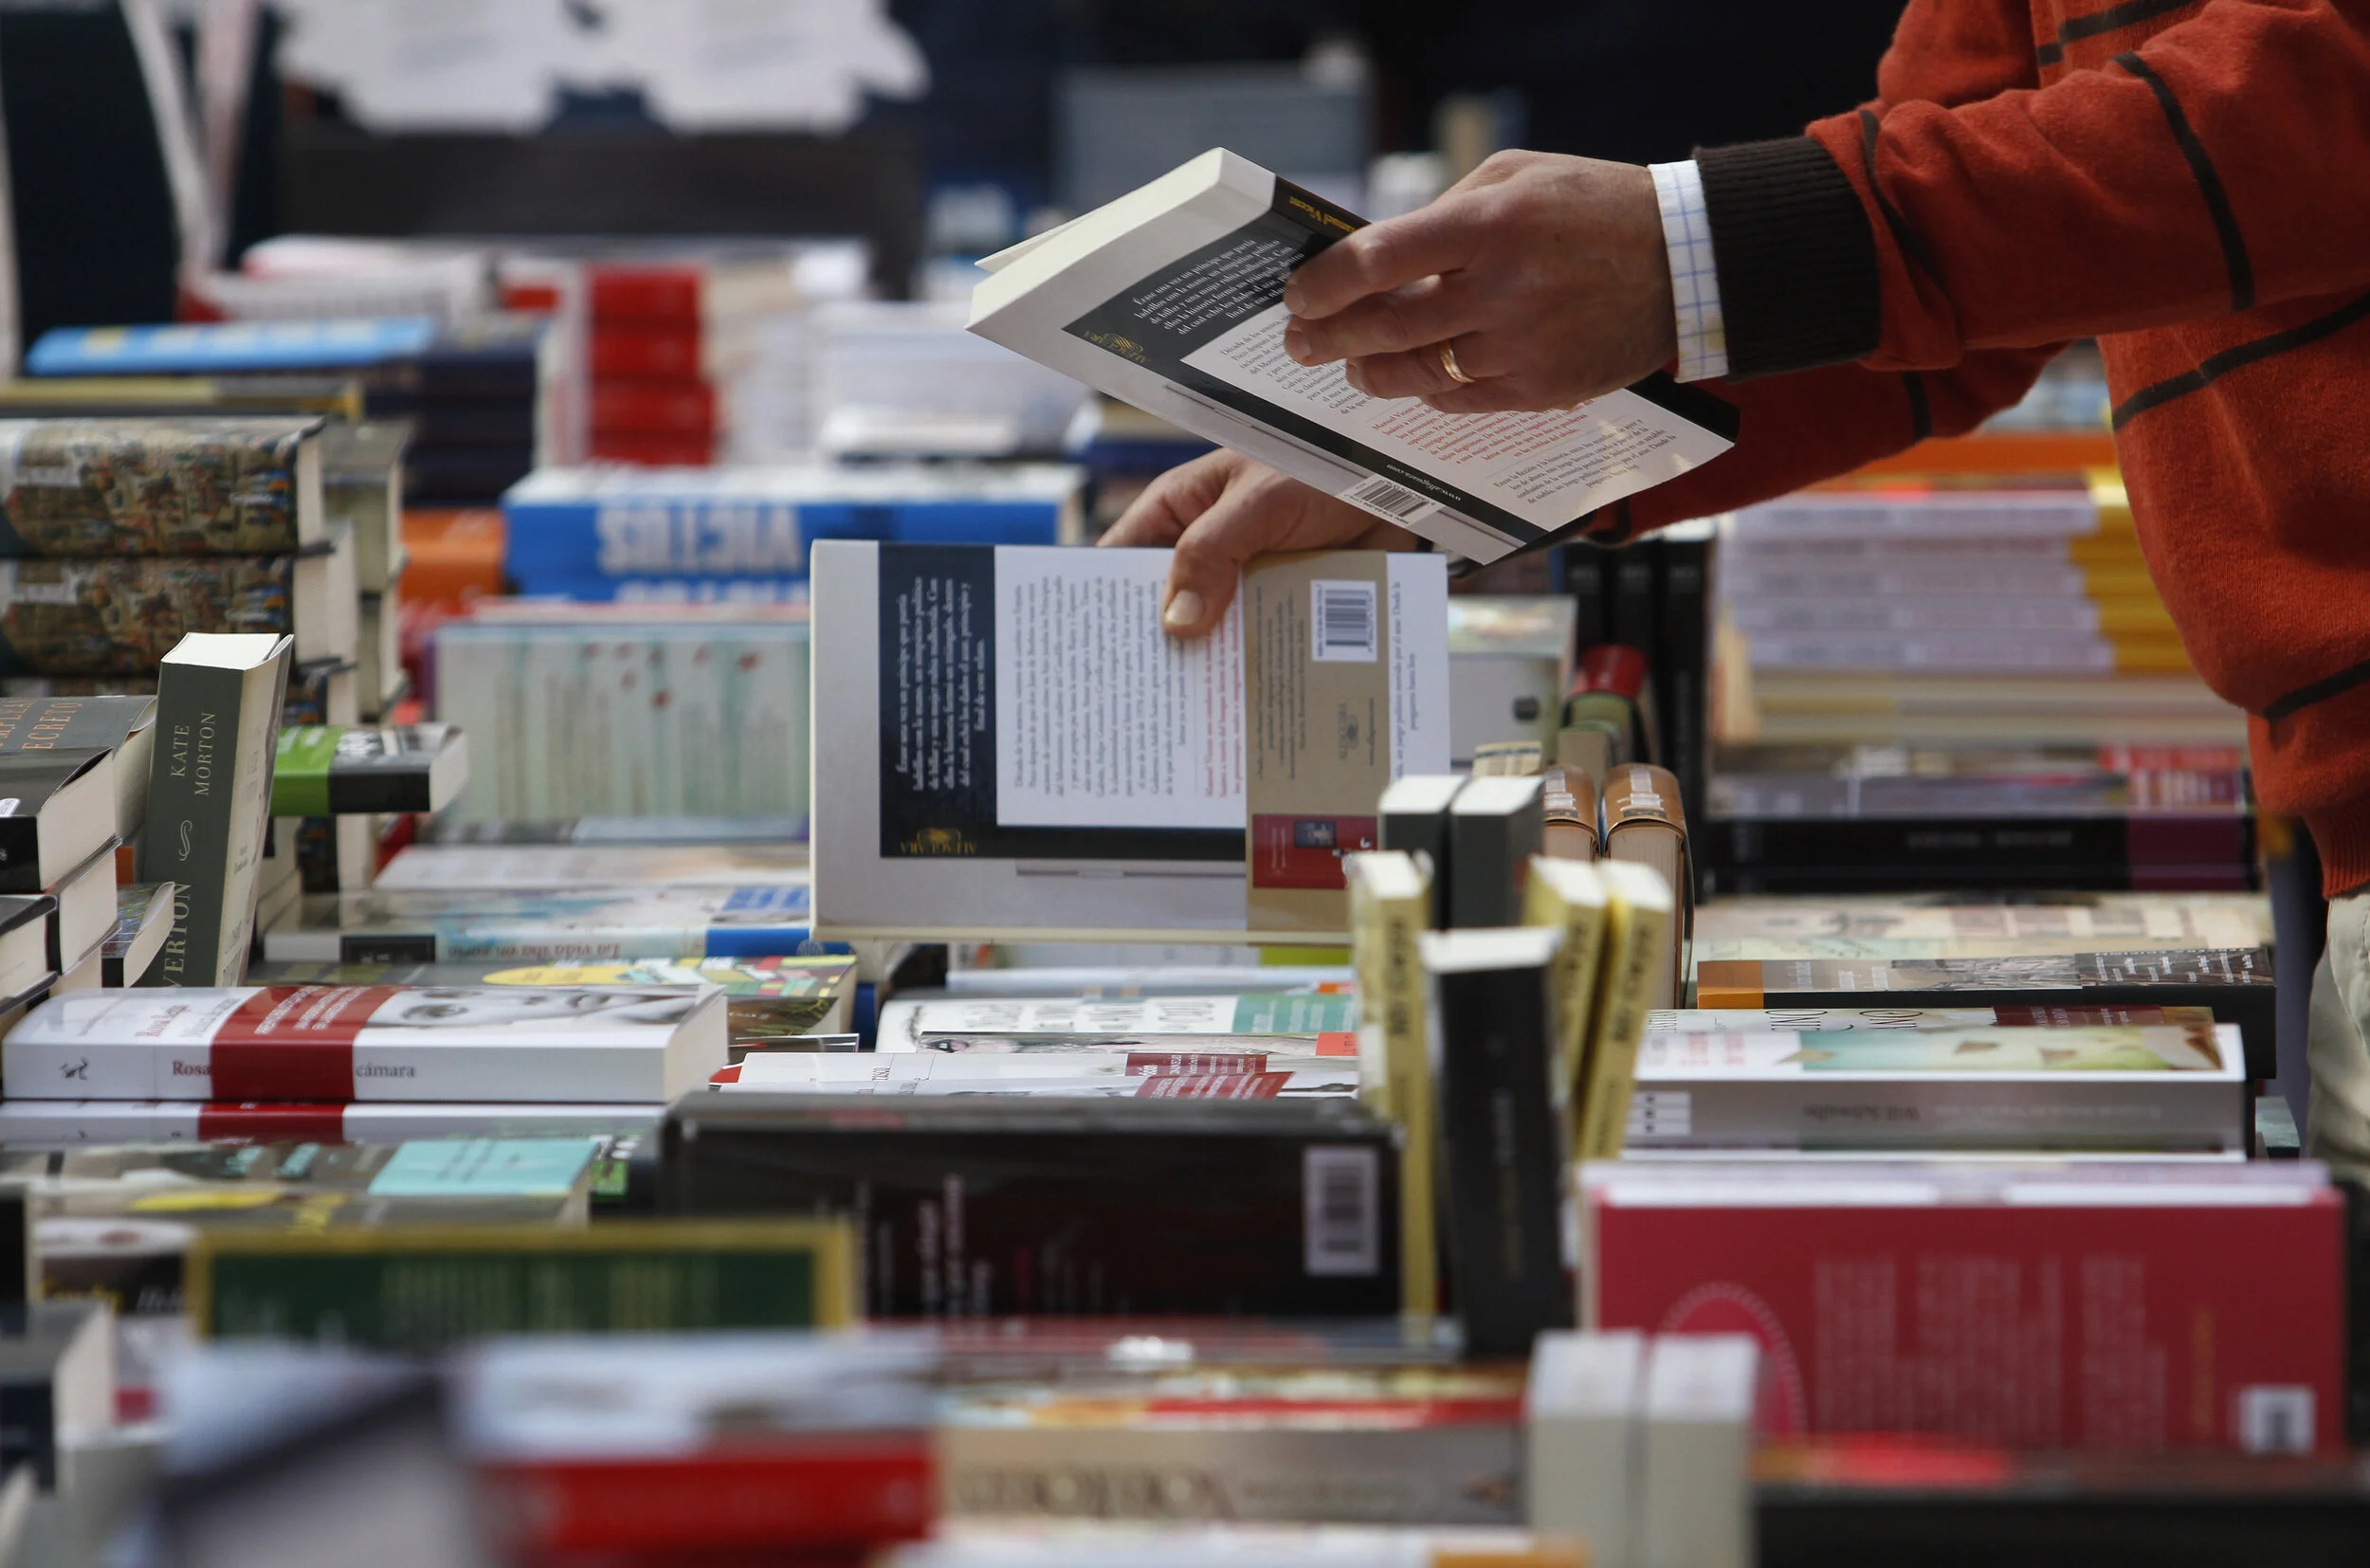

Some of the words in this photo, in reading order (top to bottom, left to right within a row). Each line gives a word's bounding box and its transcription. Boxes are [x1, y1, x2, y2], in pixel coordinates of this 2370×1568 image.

[172, 724, 190, 777] KATE
[194, 712, 217, 796] MORTON
[173, 1060, 210, 1077] Rosa
[356, 1061, 416, 1079] cámara
